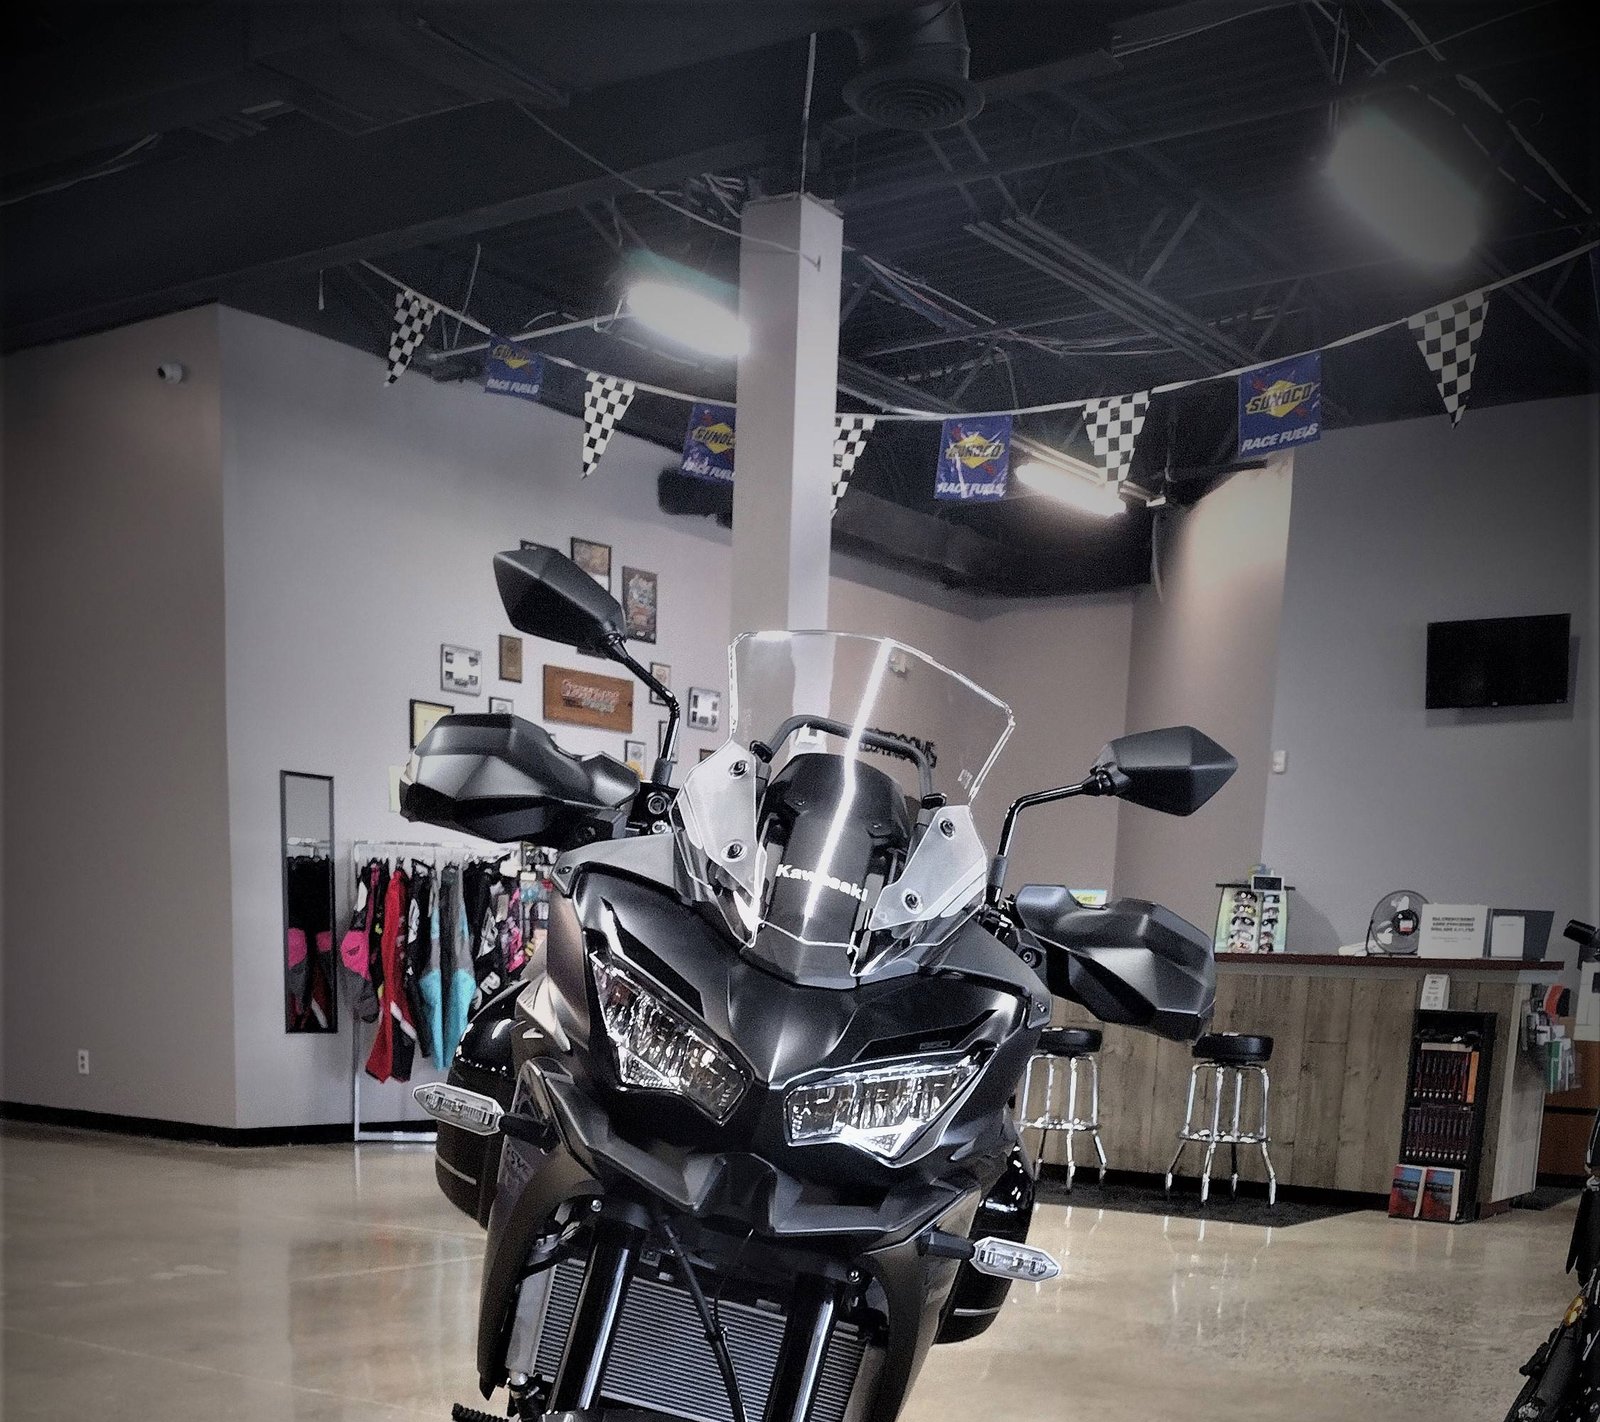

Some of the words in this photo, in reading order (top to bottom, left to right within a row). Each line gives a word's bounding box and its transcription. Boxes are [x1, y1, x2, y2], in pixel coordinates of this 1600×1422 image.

[1246, 383, 1314, 413] SUNOCO
[1241, 433, 1280, 452] RACE
[1280, 423, 1319, 443] FUELS
[776, 864, 868, 902] Kawsaki
